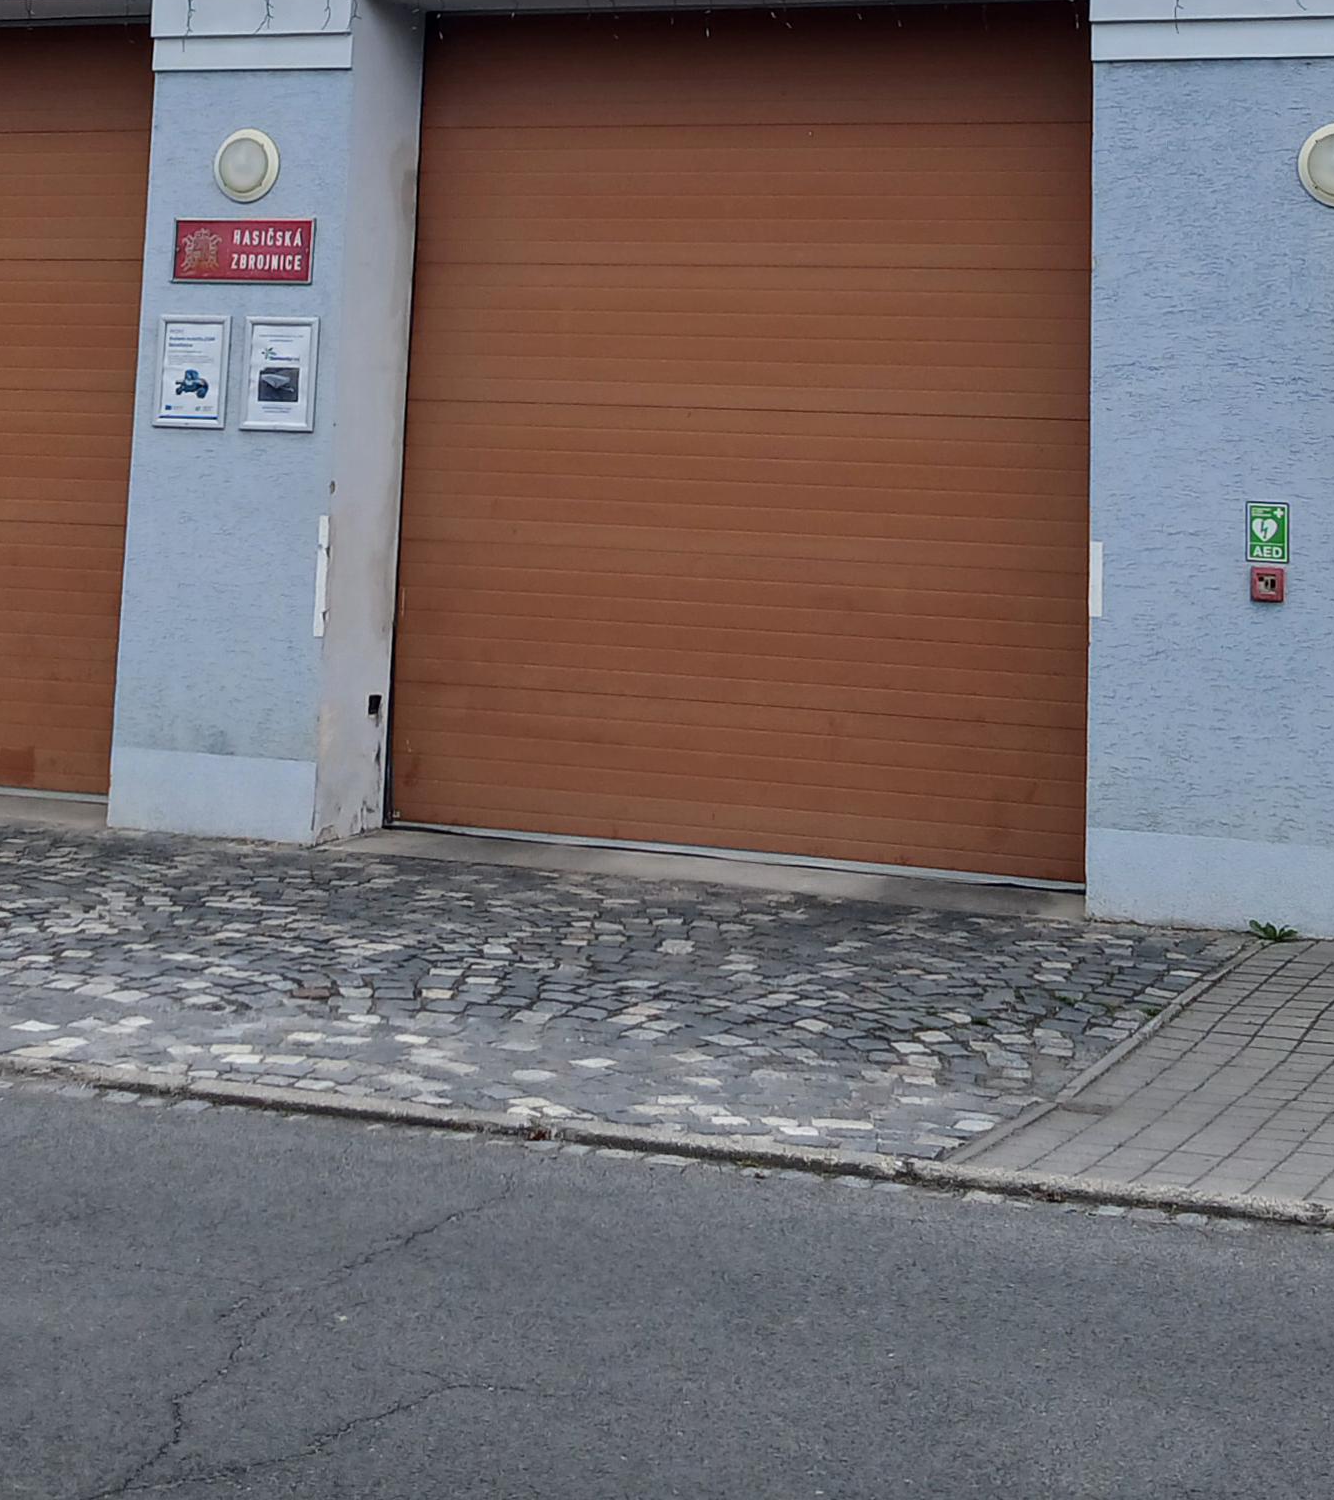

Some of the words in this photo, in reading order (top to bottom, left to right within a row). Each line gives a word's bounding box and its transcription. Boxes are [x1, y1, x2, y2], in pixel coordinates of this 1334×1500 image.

[233, 228, 303, 246] HASIČSKÁ
[231, 254, 301, 270] ZBROJNICE
[1253, 546, 1282, 557] AED
